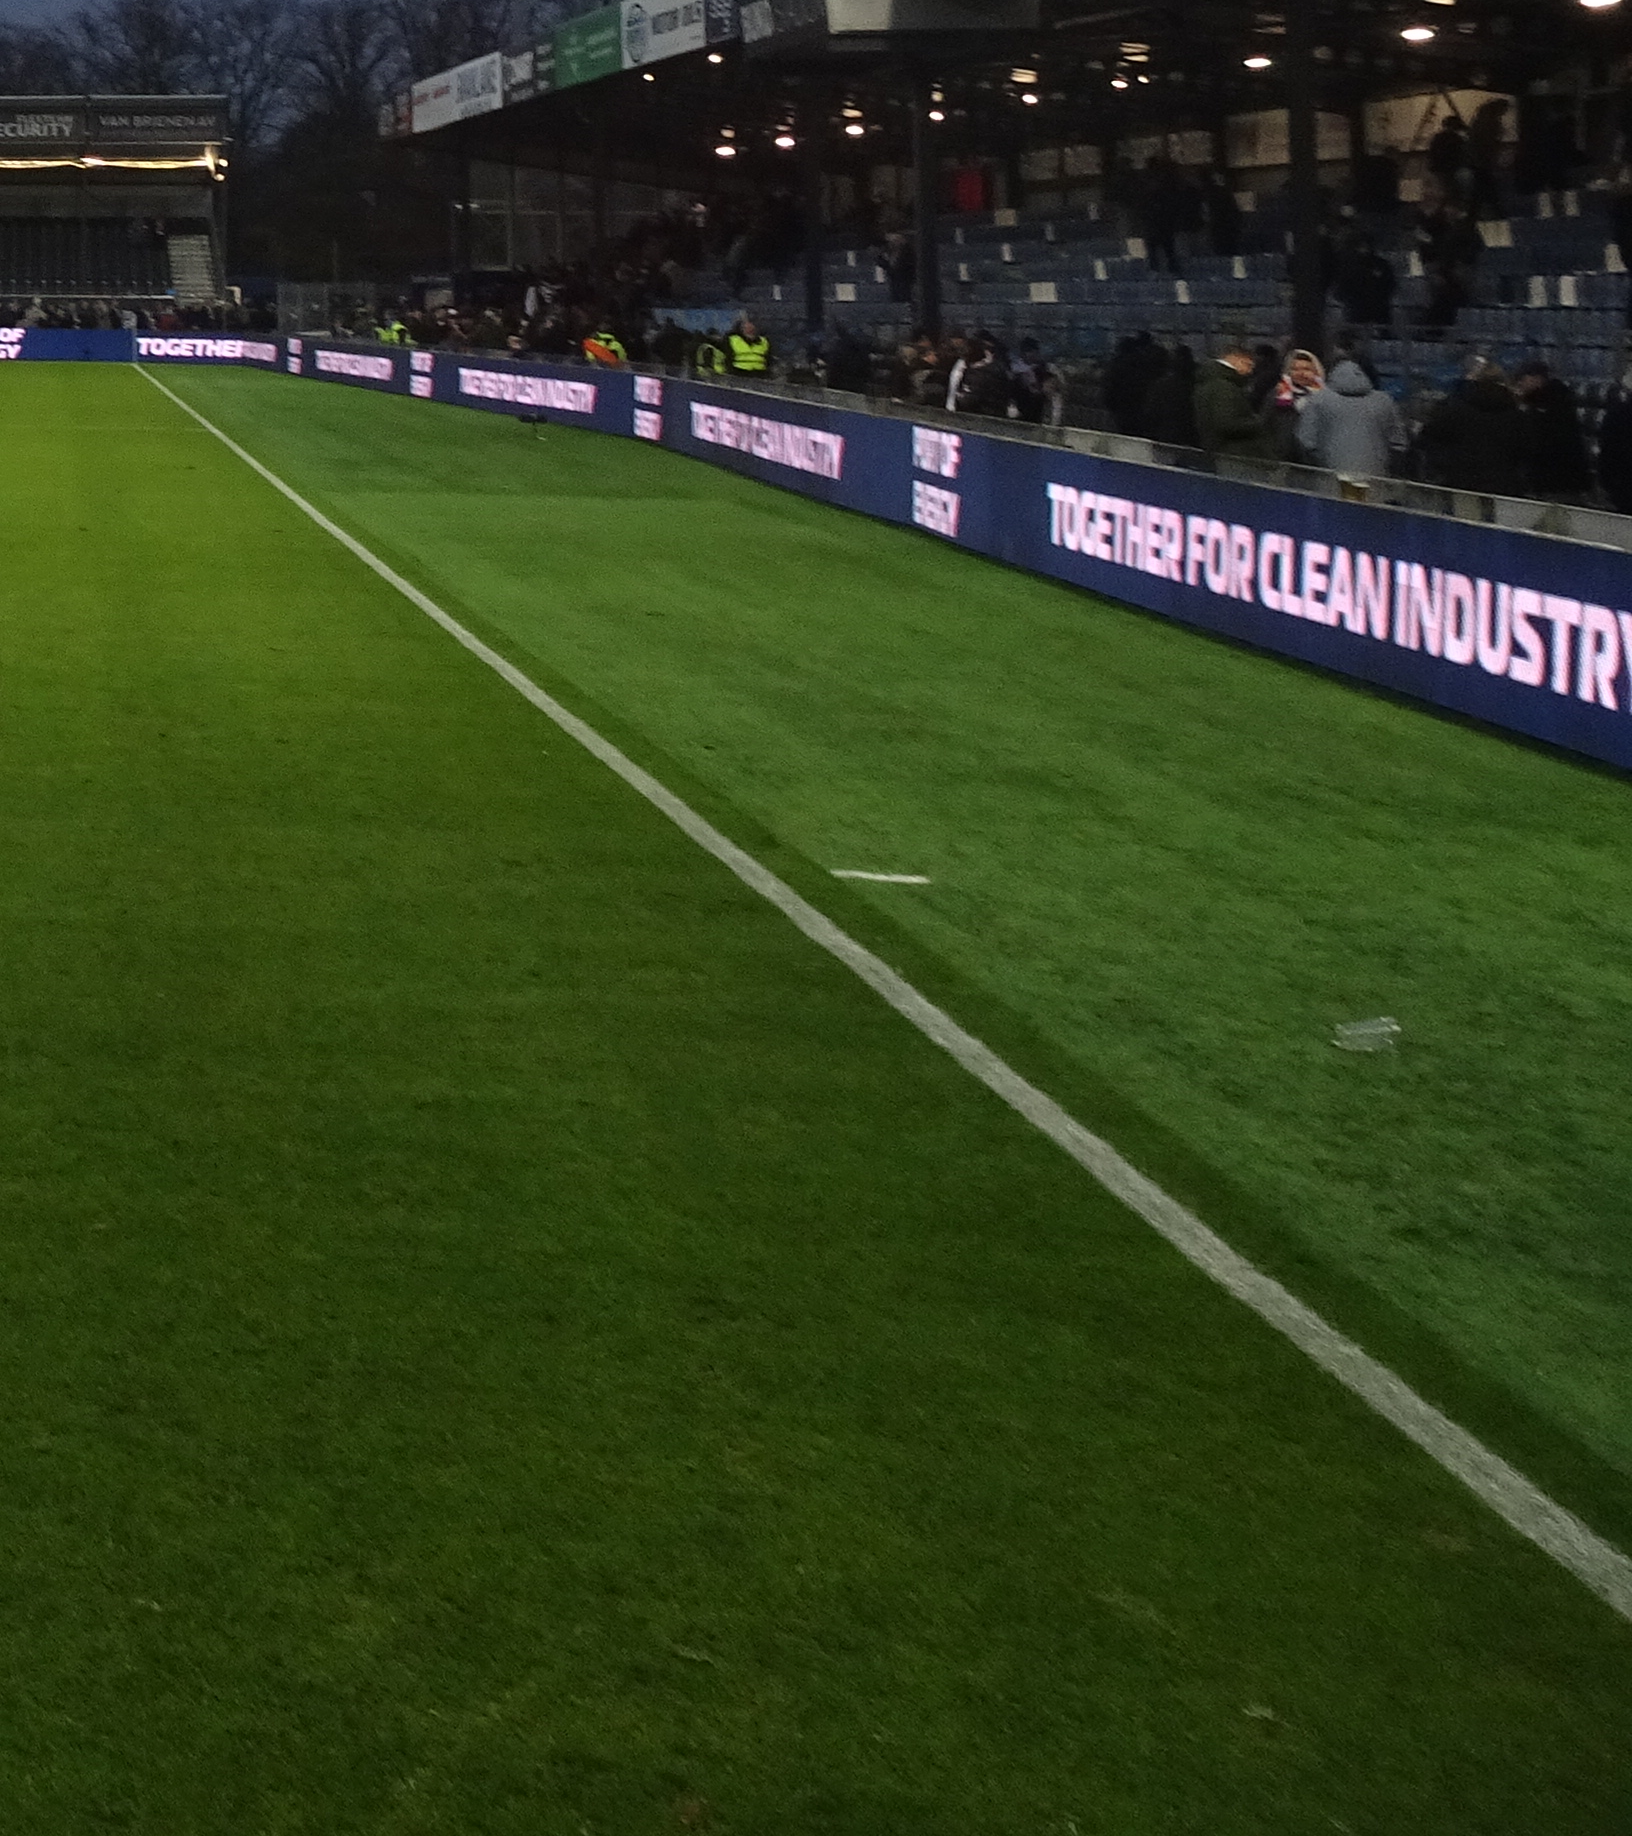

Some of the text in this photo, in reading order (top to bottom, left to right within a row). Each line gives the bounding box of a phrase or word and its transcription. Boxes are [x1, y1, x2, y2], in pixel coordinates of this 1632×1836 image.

[1046, 481, 1184, 583] TOGETHER
[1186, 515, 1256, 603] FOR
[1257, 531, 1392, 642] CLEAN
